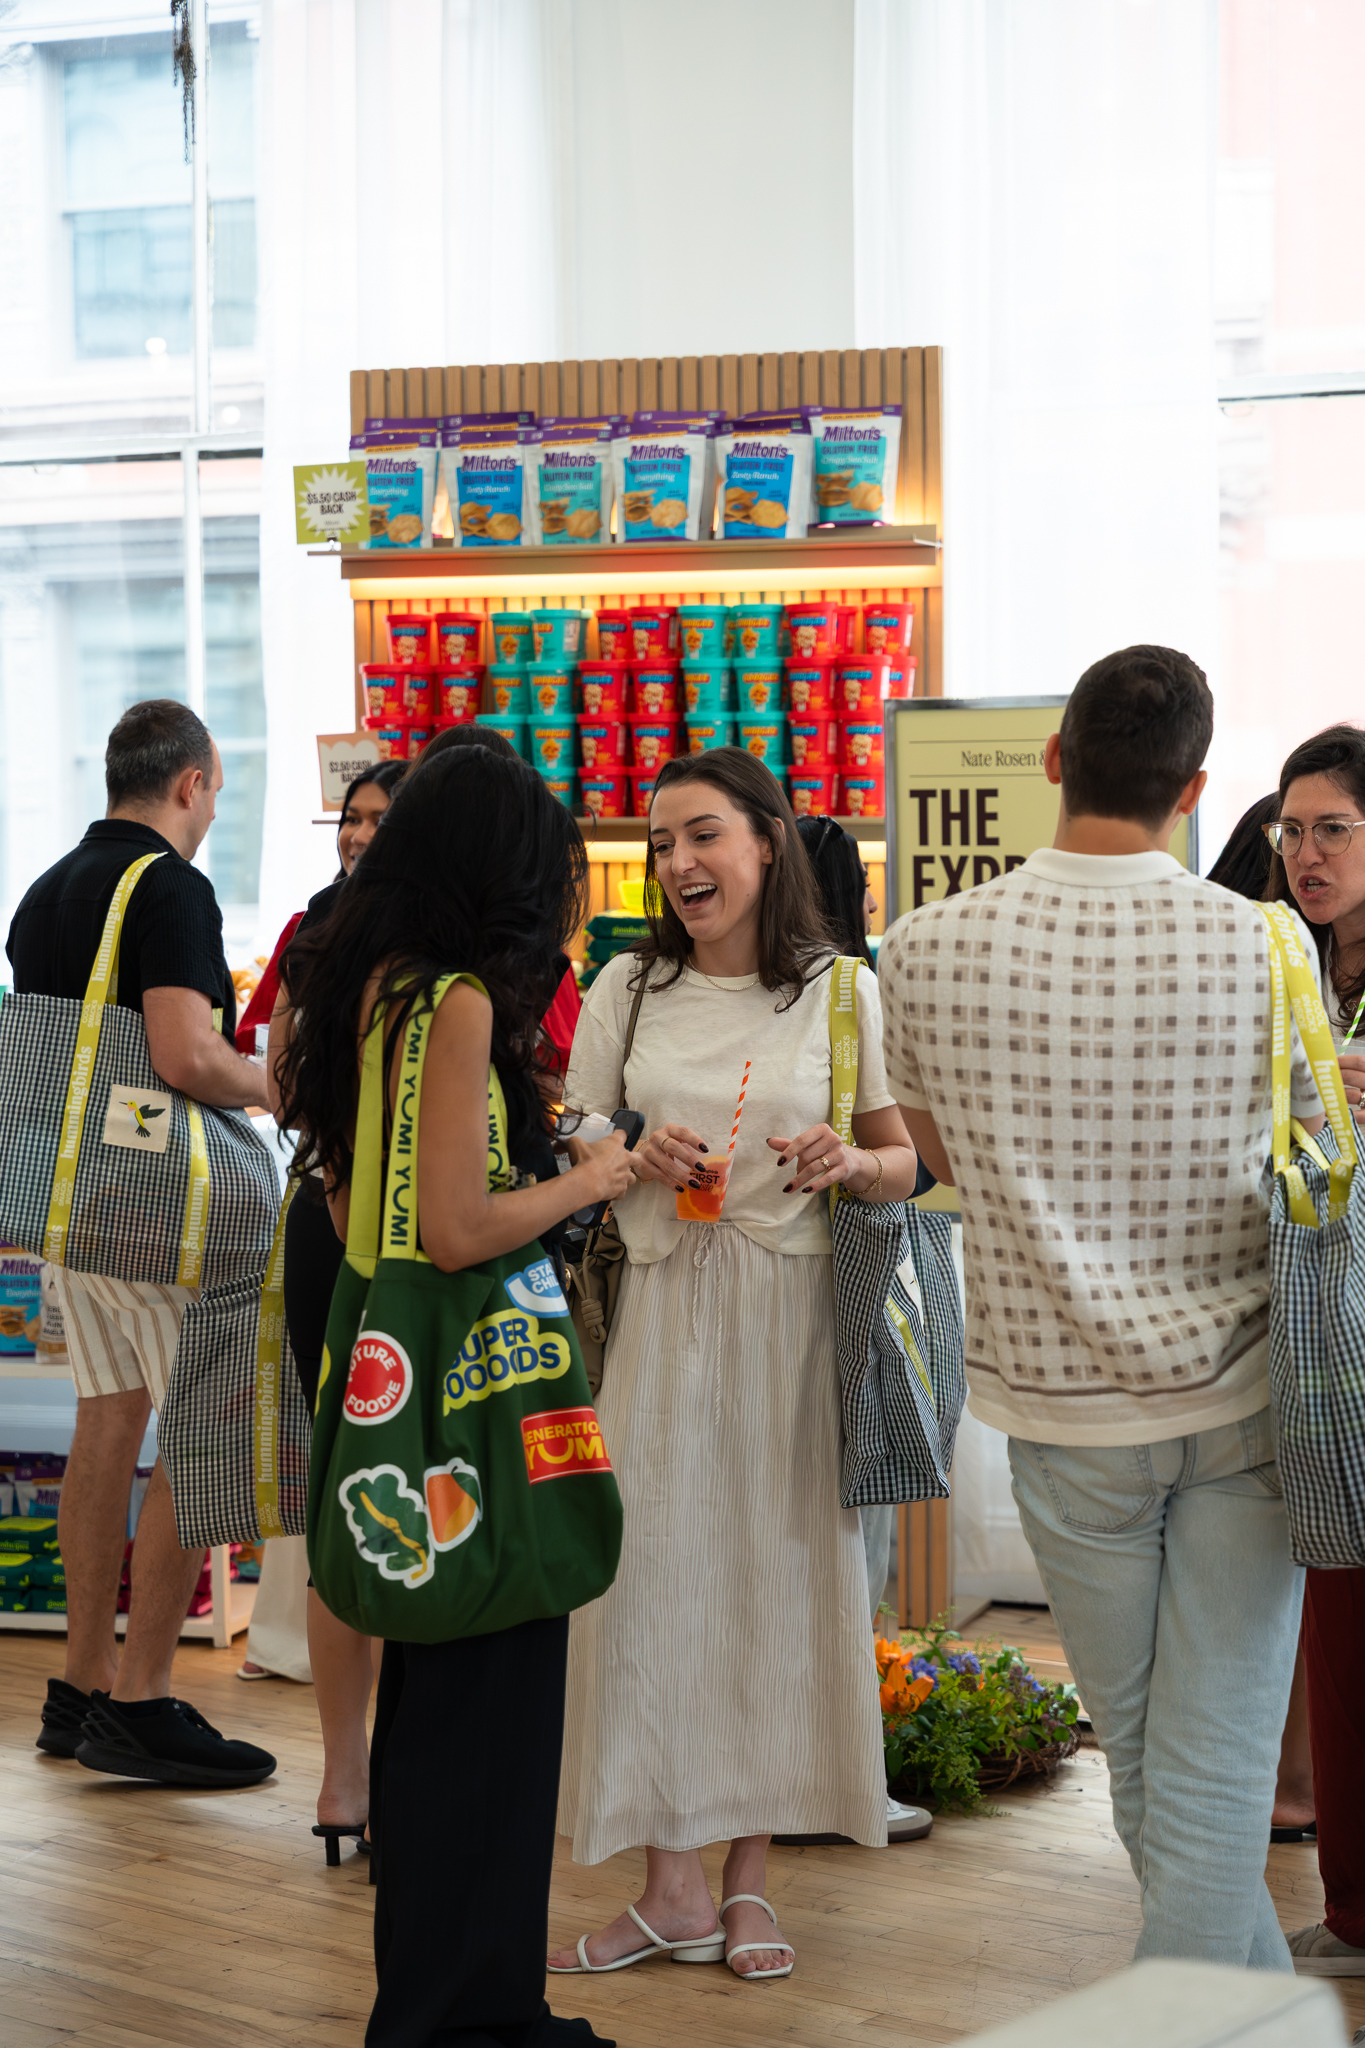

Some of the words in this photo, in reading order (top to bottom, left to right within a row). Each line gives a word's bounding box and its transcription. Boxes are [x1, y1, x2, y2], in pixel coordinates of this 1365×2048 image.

[822, 426, 881, 442] Milton's
[543, 453, 596, 469] Milton's
[629, 445, 685, 462] Milton's
[730, 442, 787, 458] Milton's
[366, 458, 417, 473] Milton's
[462, 456, 517, 472] Milton's
[333, 491, 357, 502] CASH
[320, 504, 344, 515] BACK
[961, 751, 992, 767] Nate
[995, 751, 1036, 767] Rosen
[909, 788, 1000, 846] THE
[92, 874, 127, 982] hummingbirds
[1301, 993, 1318, 1034] SNACKS
[1312, 1000, 1326, 1027] COOL
[843, 1035, 851, 1069] SNACKS
[60, 1045, 93, 1160] hummingbirds
[397, 1074, 417, 1155] YUMI
[390, 1165, 411, 1246] YUMI
[182, 1176, 208, 1280] hummingbirds
[527, 1262, 554, 1282] STA
[6, 1288, 40, 1299] Everythin
[531, 1274, 559, 1294] CHIL
[260, 1316, 268, 1338] COOL
[267, 1311, 276, 1342] SNACKS
[347, 1380, 401, 1413] FOODIE
[257, 1361, 278, 1483] hummingbirds
